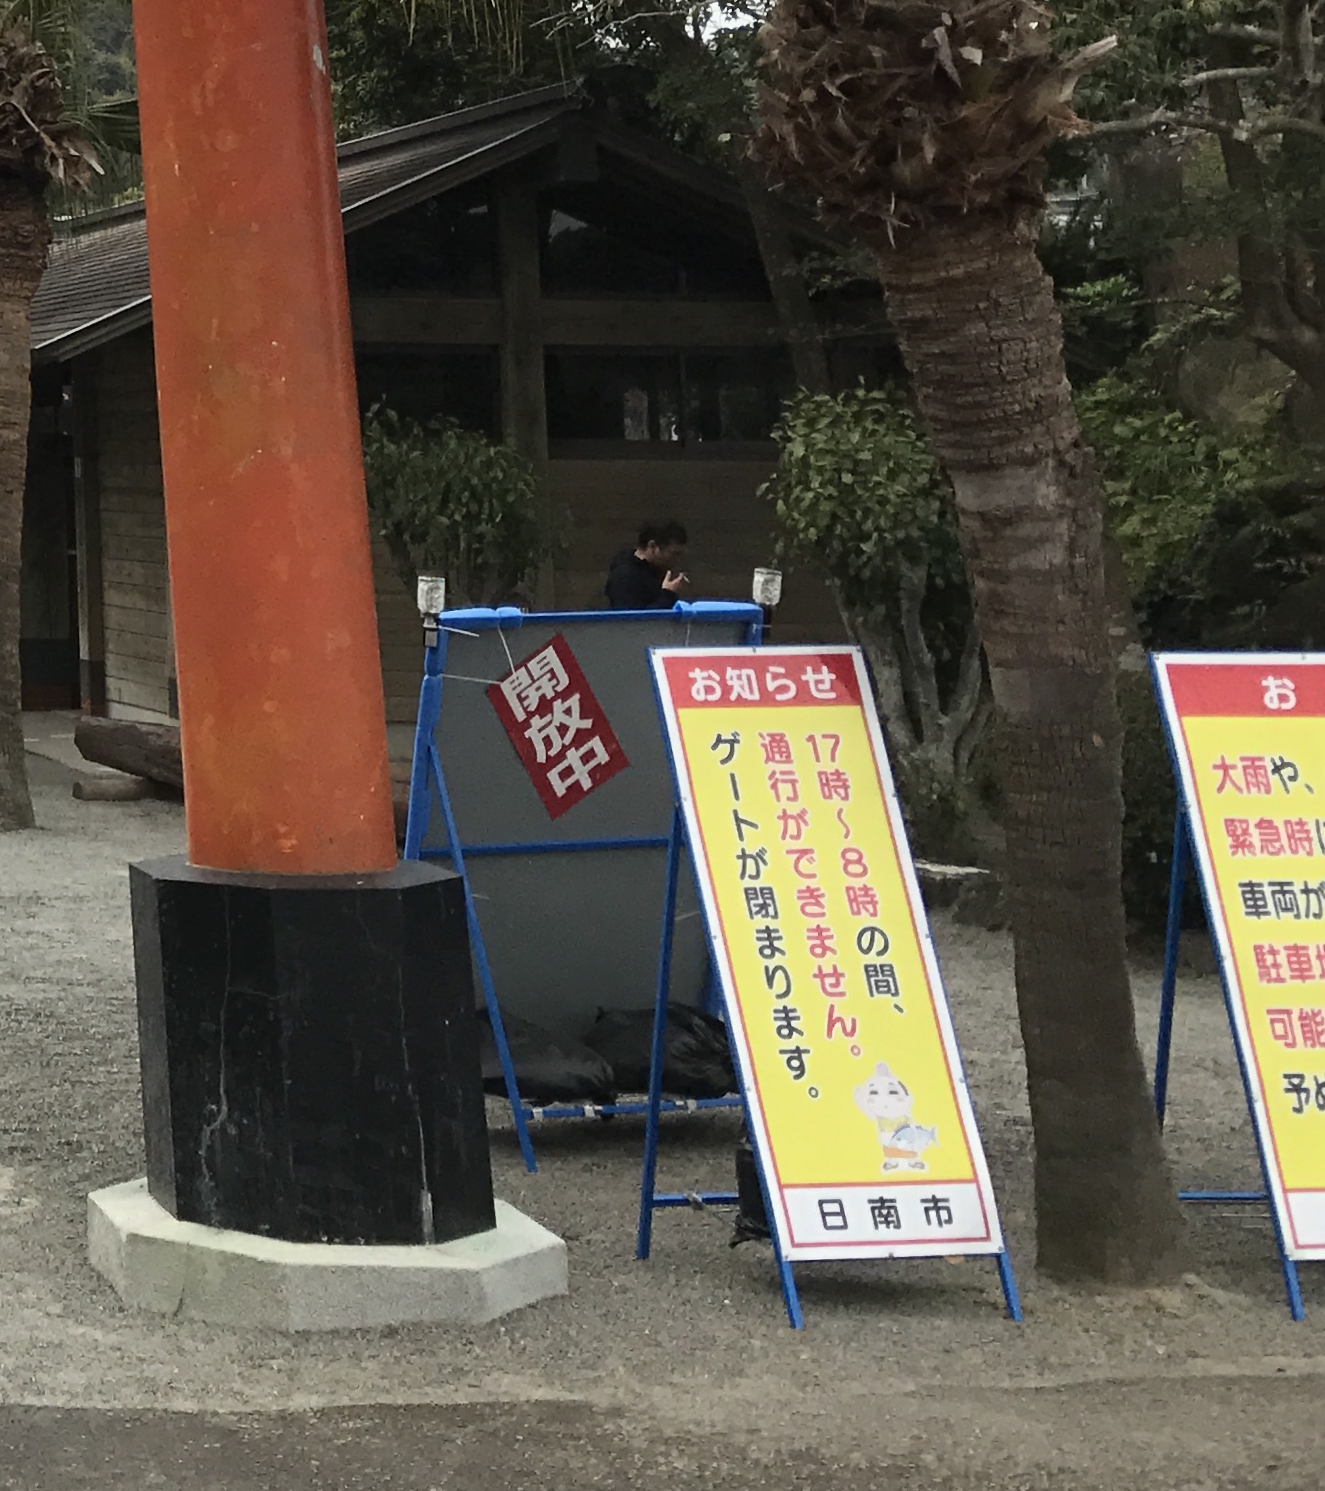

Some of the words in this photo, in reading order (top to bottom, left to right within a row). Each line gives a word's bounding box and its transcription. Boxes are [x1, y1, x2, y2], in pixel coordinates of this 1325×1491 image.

[688, 666, 837, 701] お知らせ
[1261, 675, 1297, 710] お
[500, 645, 610, 797] 開放中
[1212, 755, 1315, 795] 大雨や、
[758, 731, 861, 1057] 通行ができません。
[711, 730, 819, 1099] ゲートが閉まります。
[818, 1195, 954, 1231] 日南市
